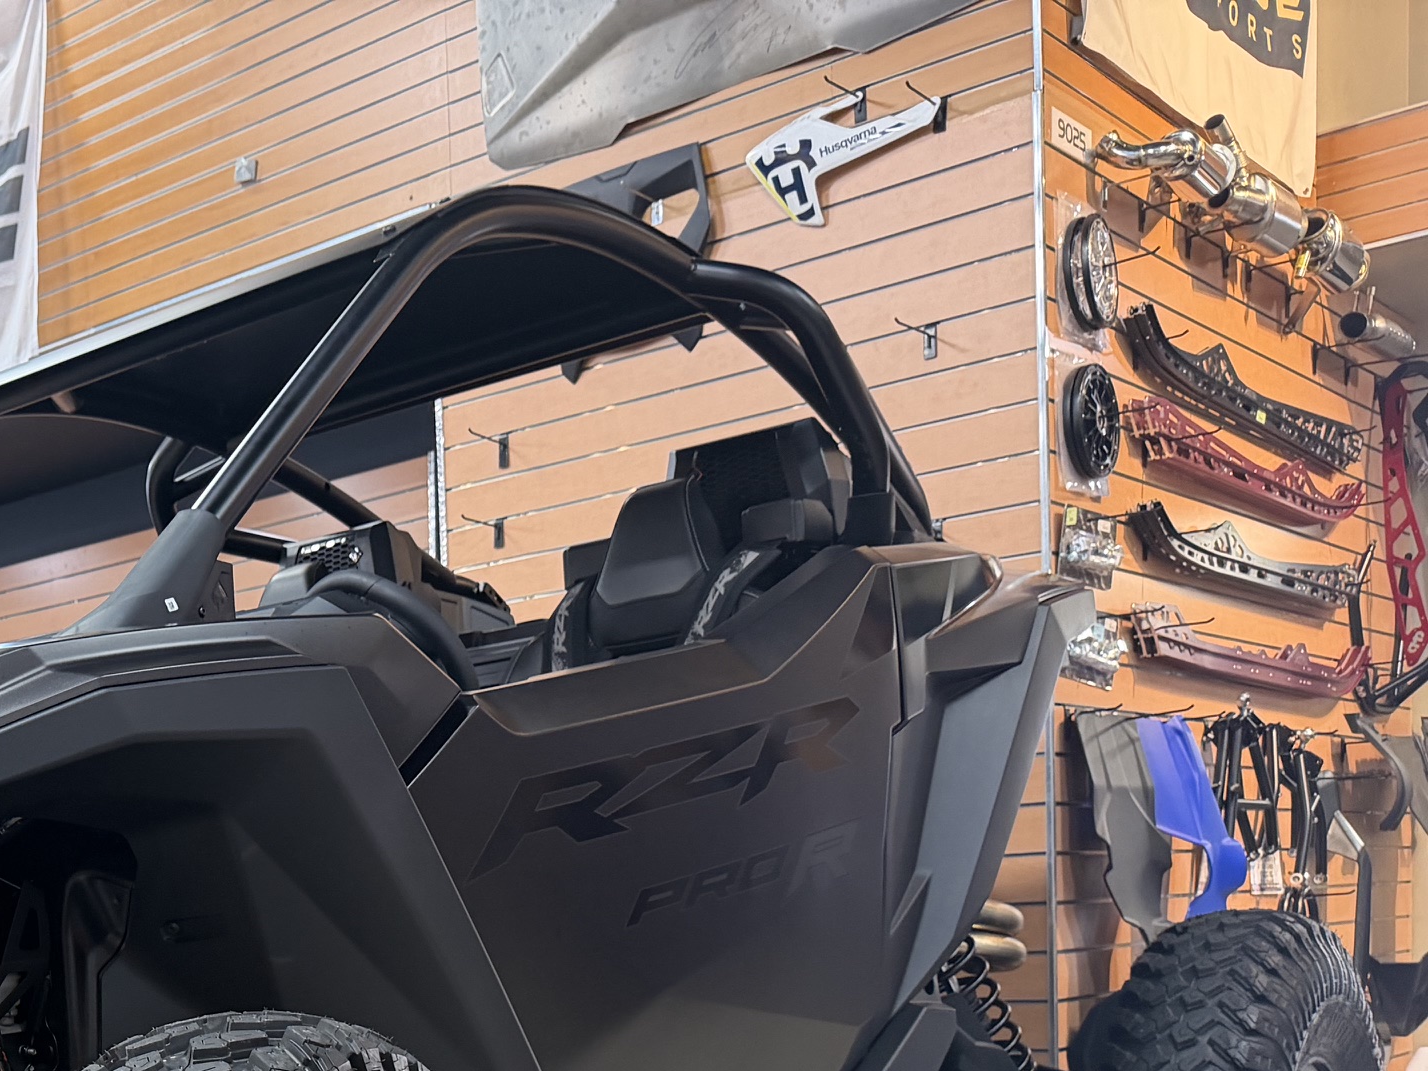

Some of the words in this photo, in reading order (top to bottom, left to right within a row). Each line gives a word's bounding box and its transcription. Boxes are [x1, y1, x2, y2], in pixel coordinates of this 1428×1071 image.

[1217, 0, 1303, 60] ORTS
[819, 125, 878, 158] Husqvarna
[1057, 117, 1087, 152] 9025
[464, 696, 860, 888] RZR
